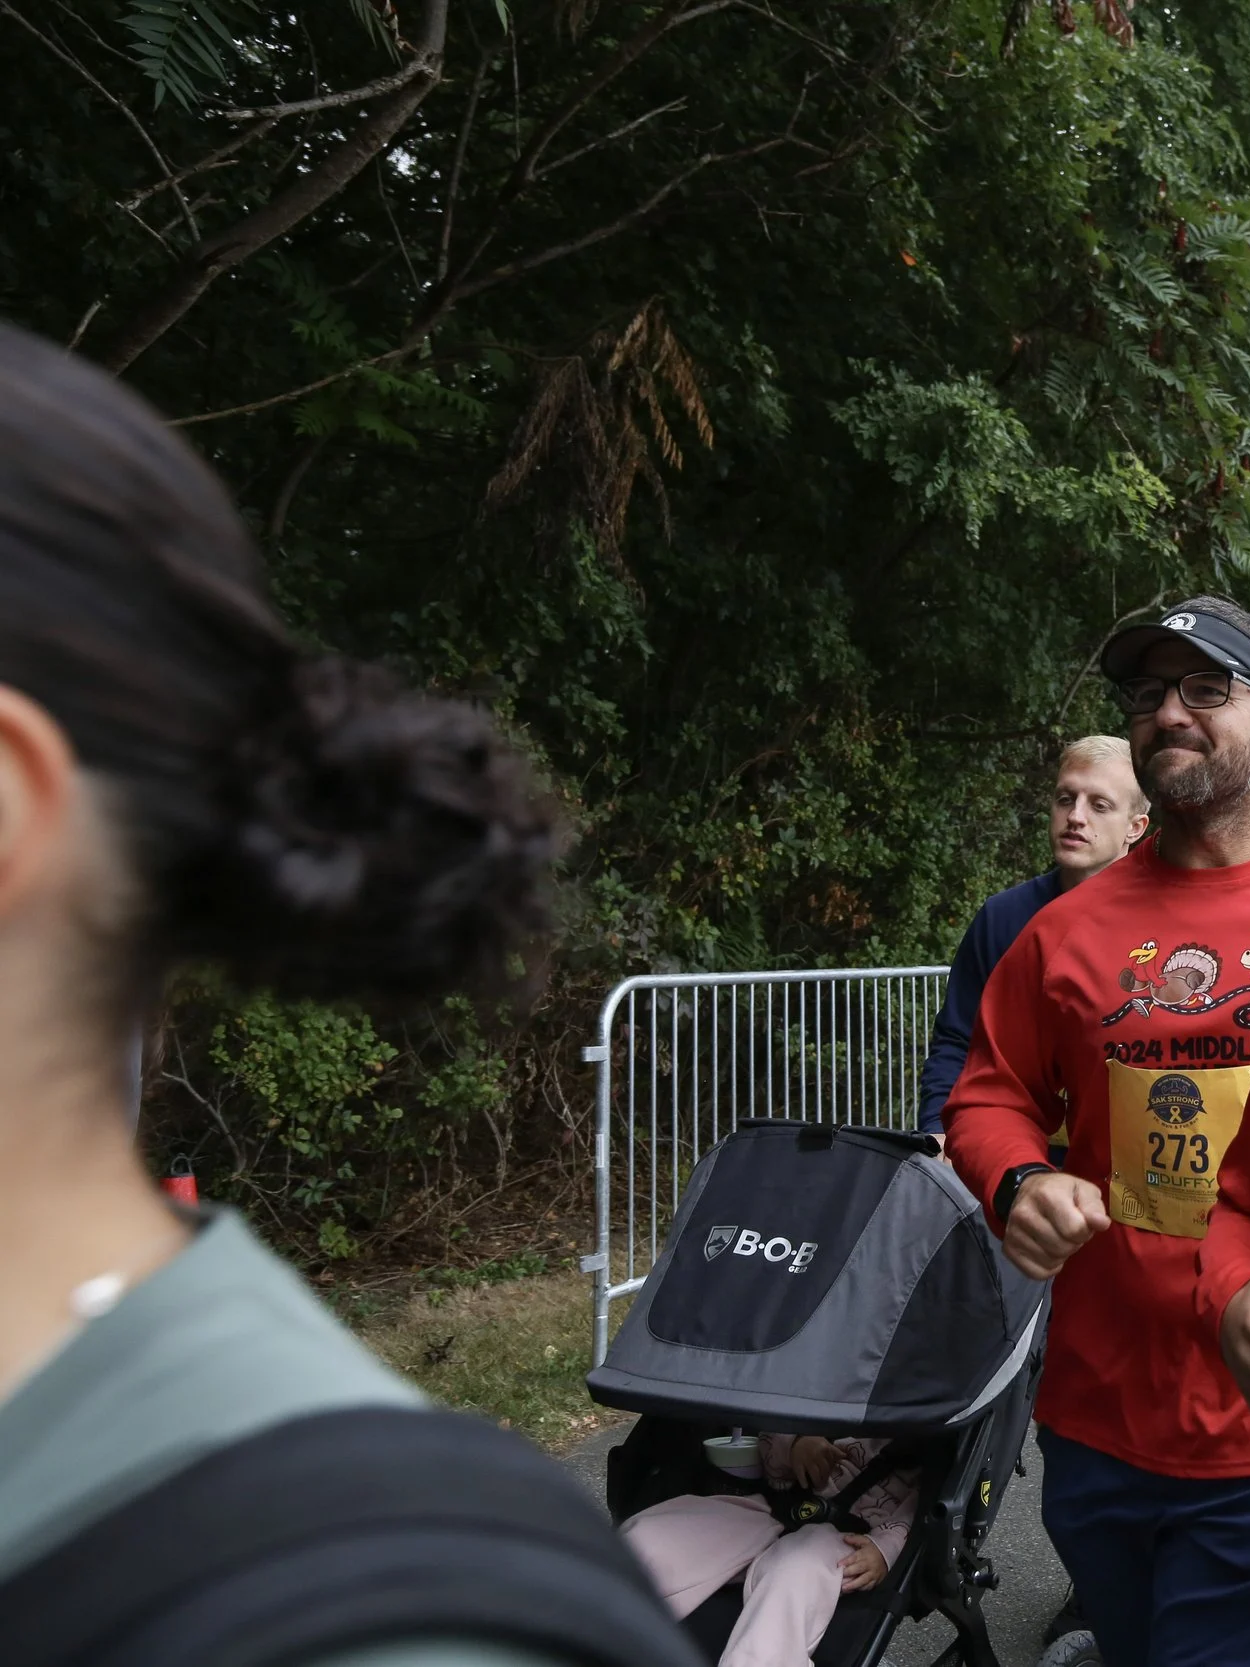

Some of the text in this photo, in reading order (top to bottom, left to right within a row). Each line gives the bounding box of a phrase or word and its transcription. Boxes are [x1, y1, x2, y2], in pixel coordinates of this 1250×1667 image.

[1103, 1040, 1164, 1063] 2024
[1151, 1095, 1200, 1106] SAK STRONG
[1149, 1132, 1209, 1173] 273
[1160, 1173, 1215, 1188] DUFFY
